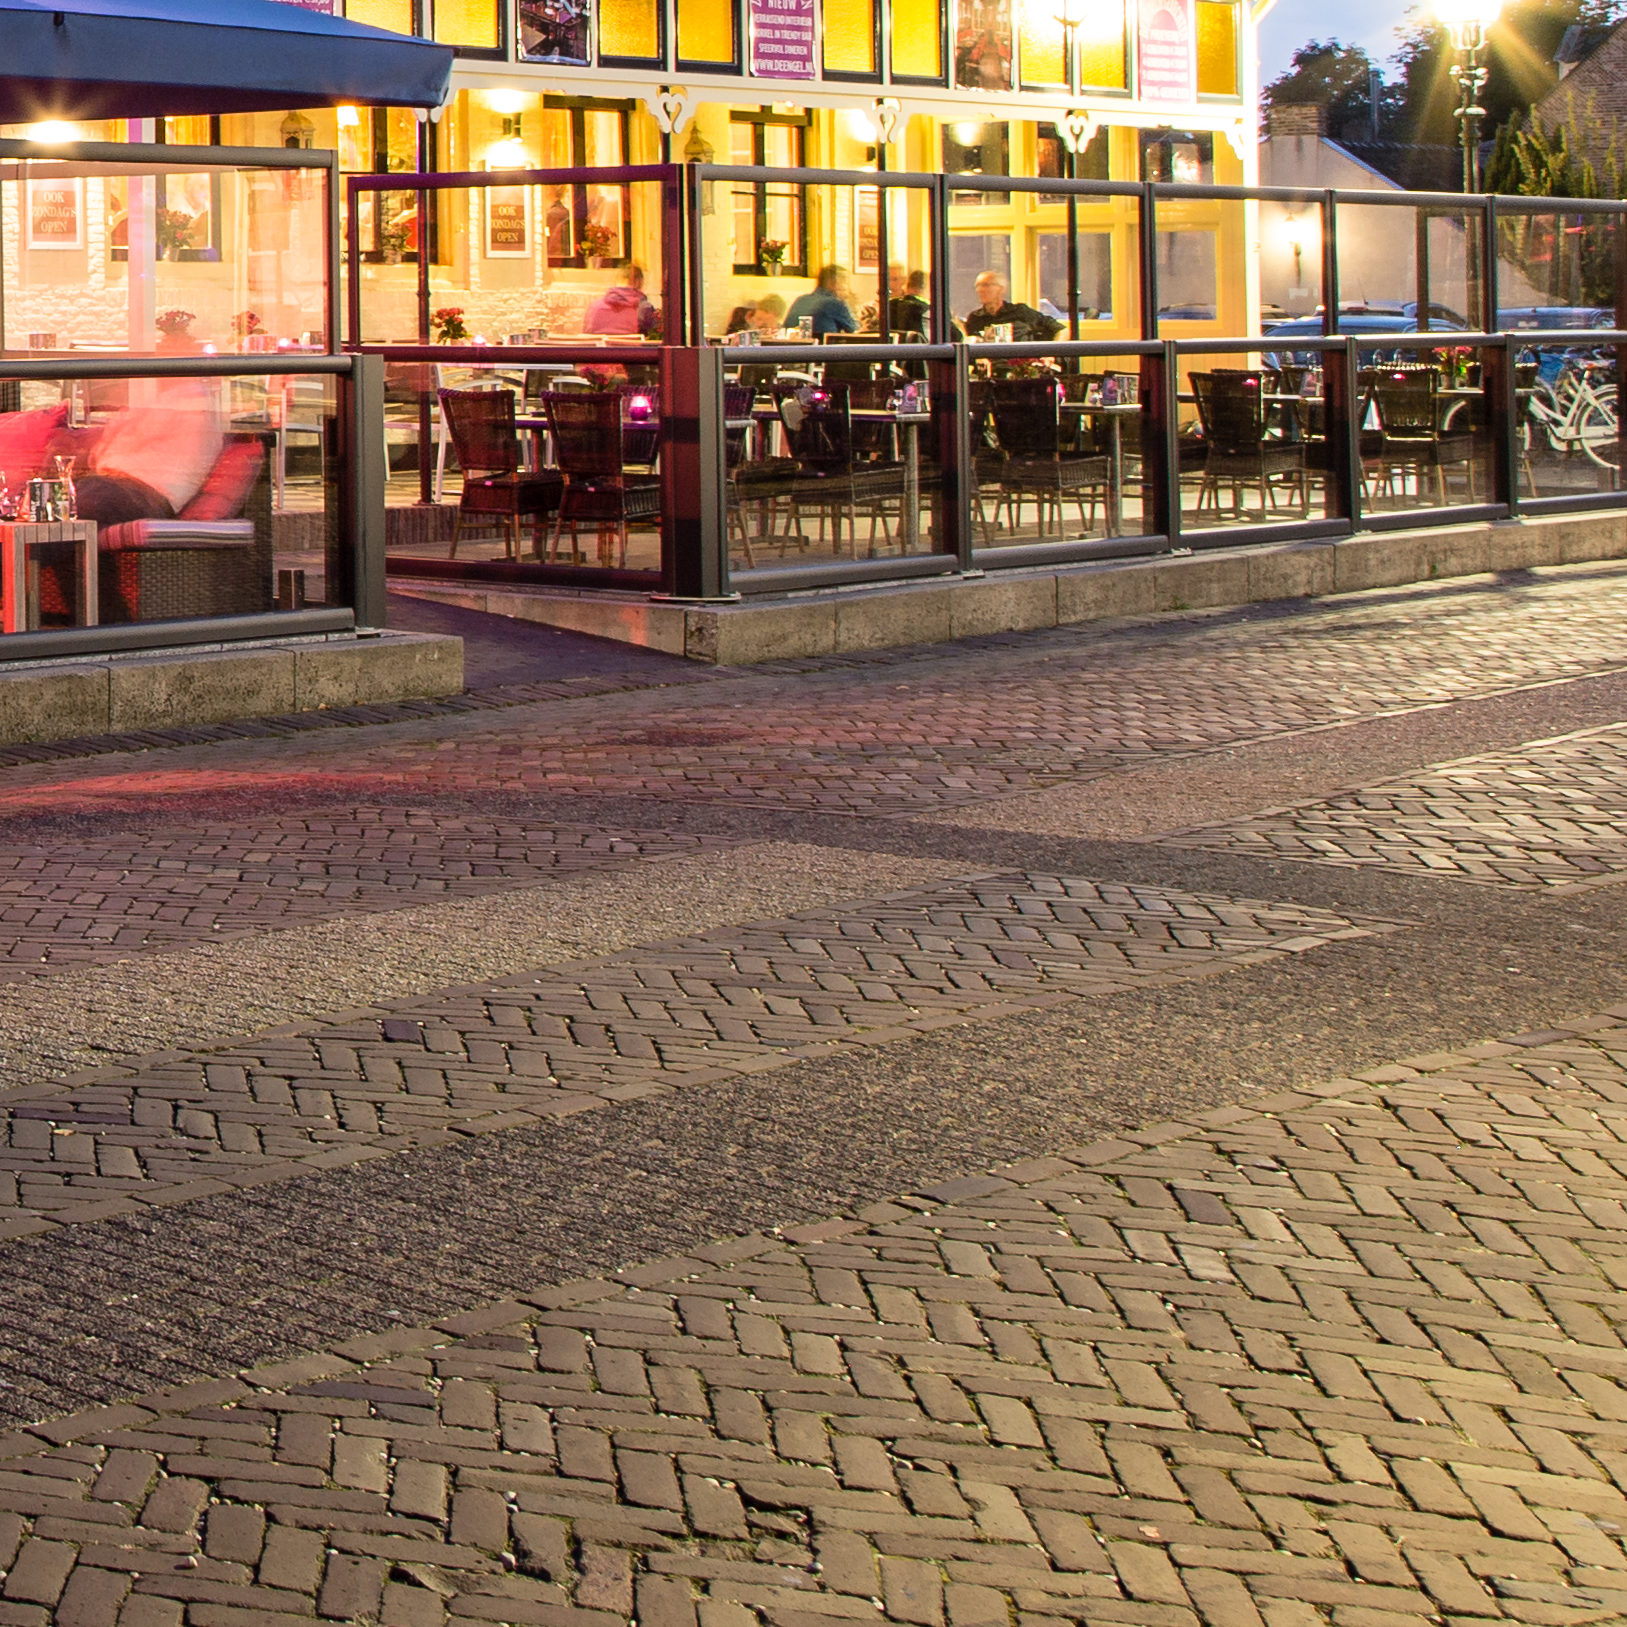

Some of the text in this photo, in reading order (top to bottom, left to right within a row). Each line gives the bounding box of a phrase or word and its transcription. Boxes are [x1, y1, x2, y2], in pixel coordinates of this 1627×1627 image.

[43, 191, 65, 203] OOK
[498, 205, 516, 217] OOK
[40, 220, 67, 233] OPEN
[496, 231, 519, 242] OPEN
